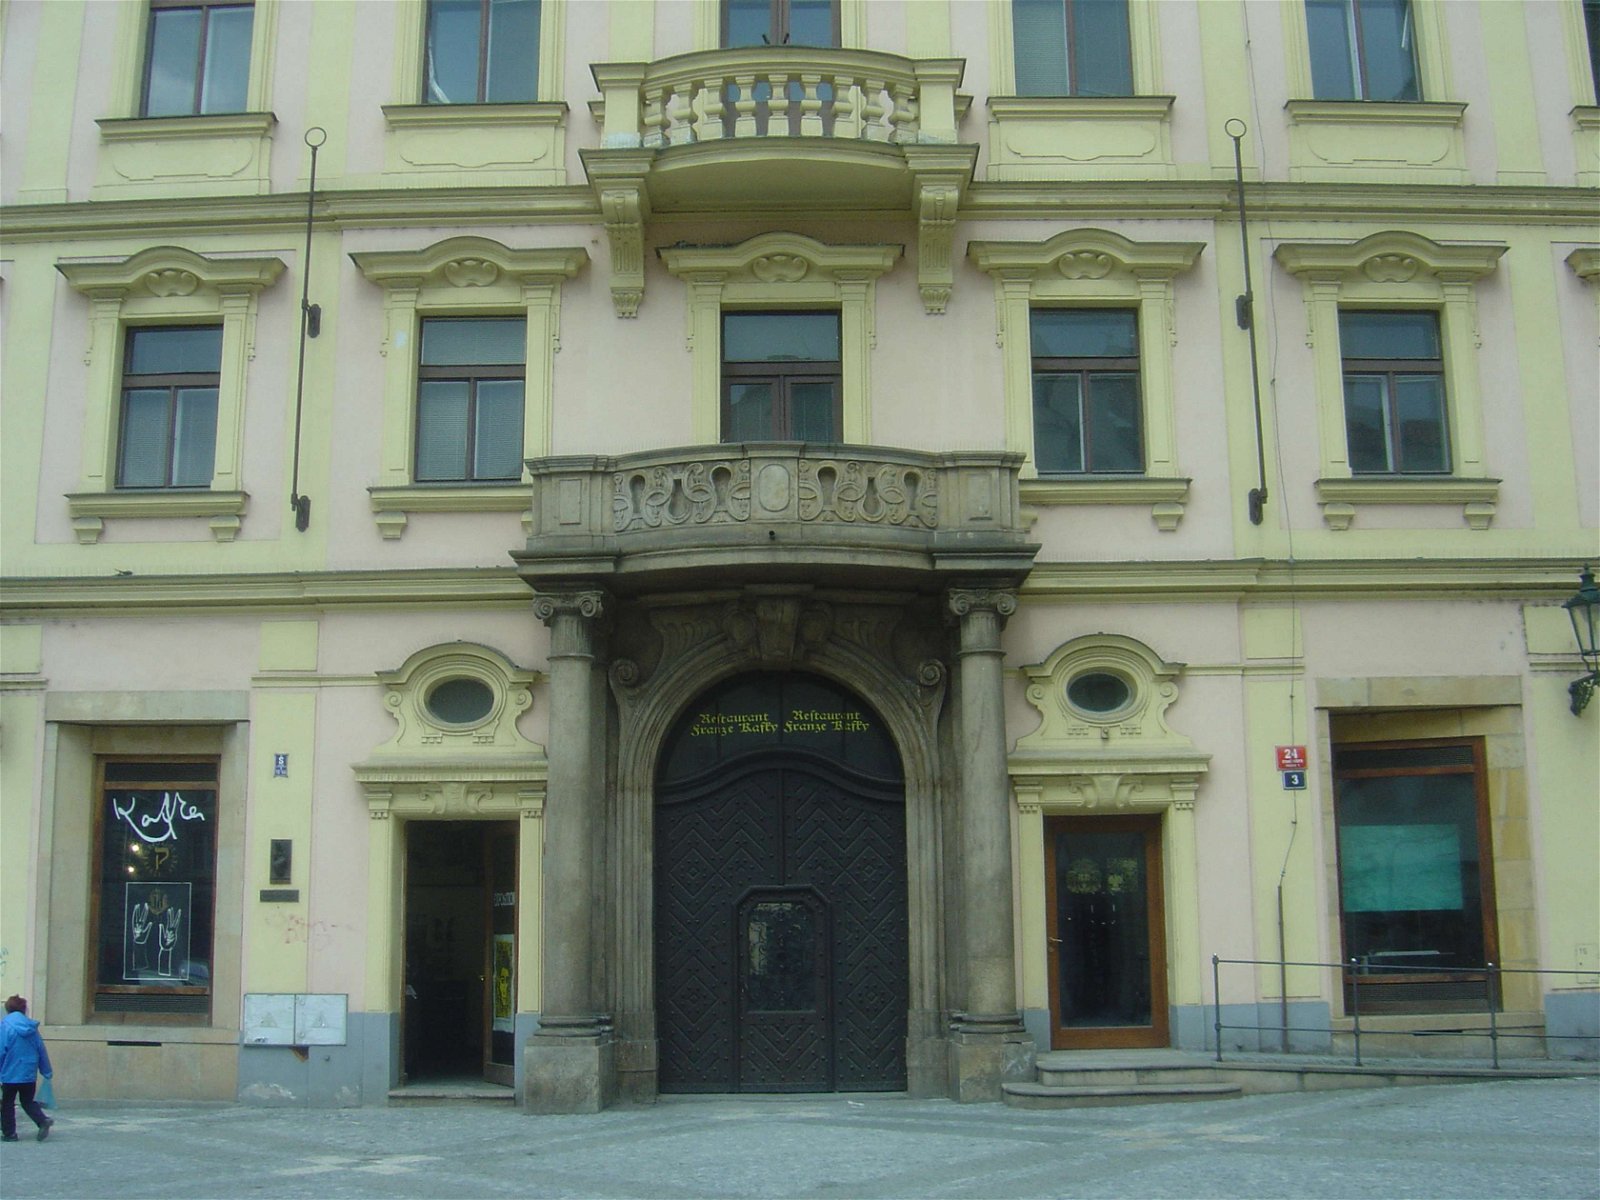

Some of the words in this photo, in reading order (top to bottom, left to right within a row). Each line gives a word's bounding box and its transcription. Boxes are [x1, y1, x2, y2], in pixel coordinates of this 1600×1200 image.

[691, 724, 734, 736] Franze
[738, 722, 779, 734] Kafky
[783, 720, 827, 734] Franze
[1284, 748, 1298, 759] 24
[1291, 774, 1299, 785] 3
